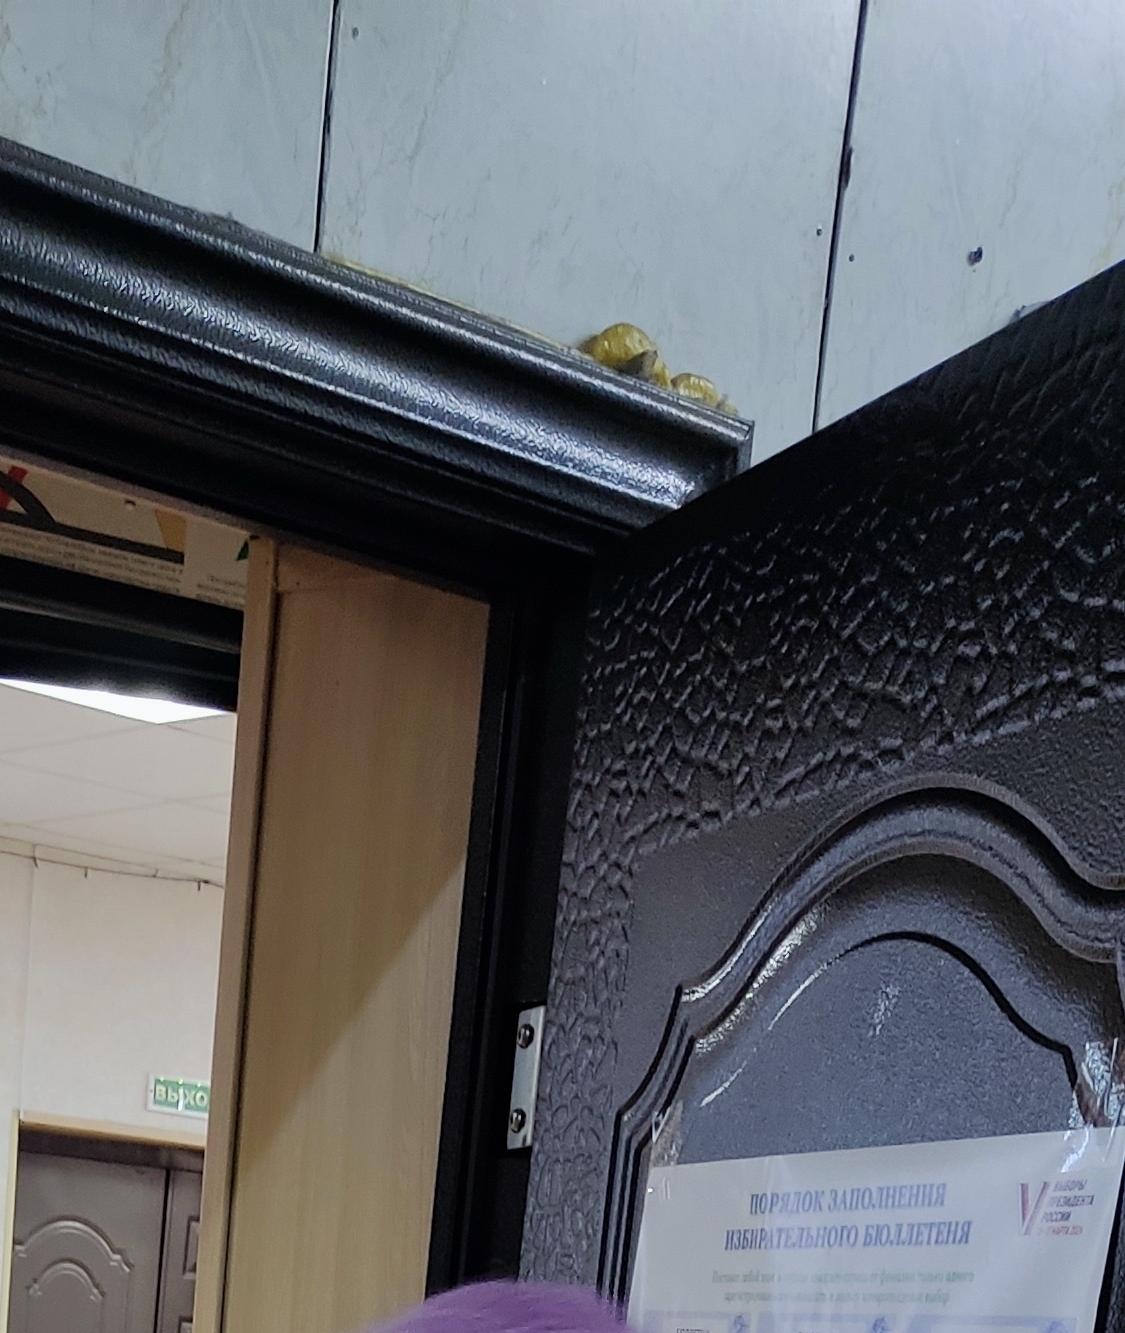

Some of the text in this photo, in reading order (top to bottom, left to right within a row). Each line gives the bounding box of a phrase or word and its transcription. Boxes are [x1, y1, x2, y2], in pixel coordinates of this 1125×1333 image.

[155, 1083, 208, 1107] ВЫХО
[750, 1183, 947, 1217] ПОРЯДОК ЗАПОЛНЕНИЯ
[725, 1220, 973, 1250] ИЗБИРАТЕЛЬНОГО БЮЛЛЕТЕНЯ
